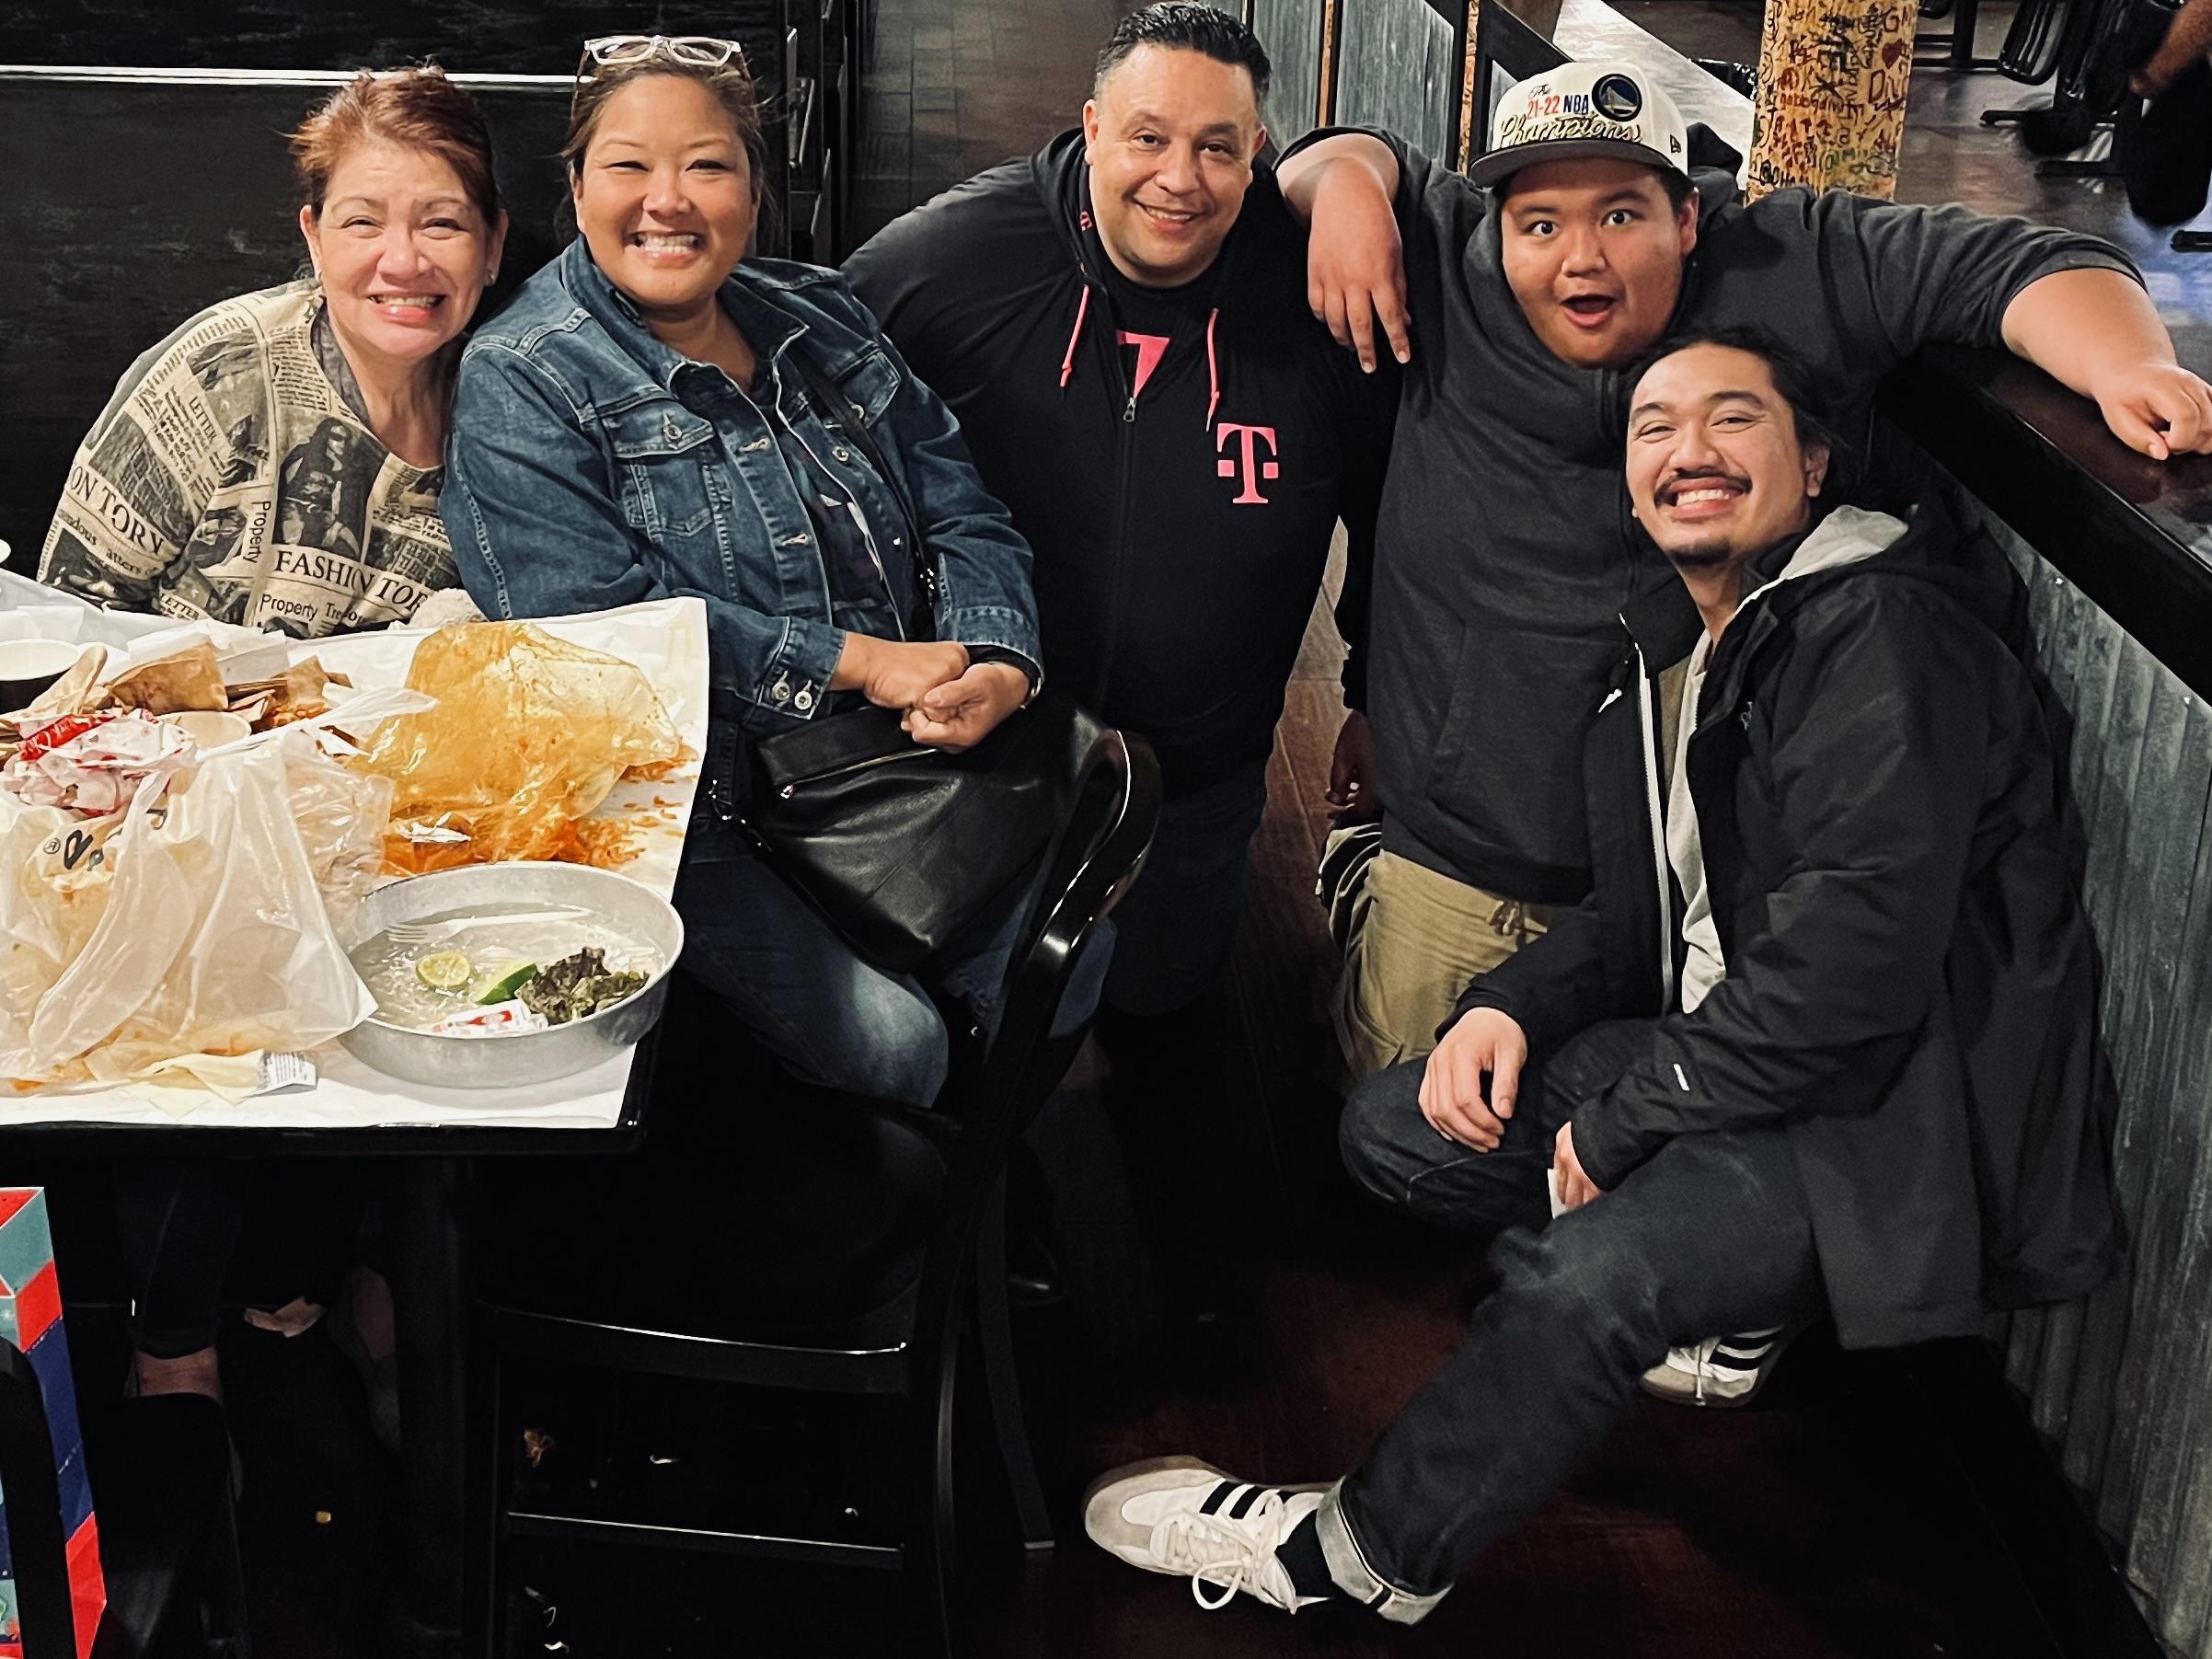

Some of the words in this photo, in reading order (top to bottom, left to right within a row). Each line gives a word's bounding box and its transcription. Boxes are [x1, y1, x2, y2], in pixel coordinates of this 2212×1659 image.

[1527, 95, 1561, 121] 21-22
[1563, 94, 1589, 115] NBA
[1216, 422, 1279, 504] T
[242, 501, 271, 564] Property
[259, 593, 318, 623] Property
